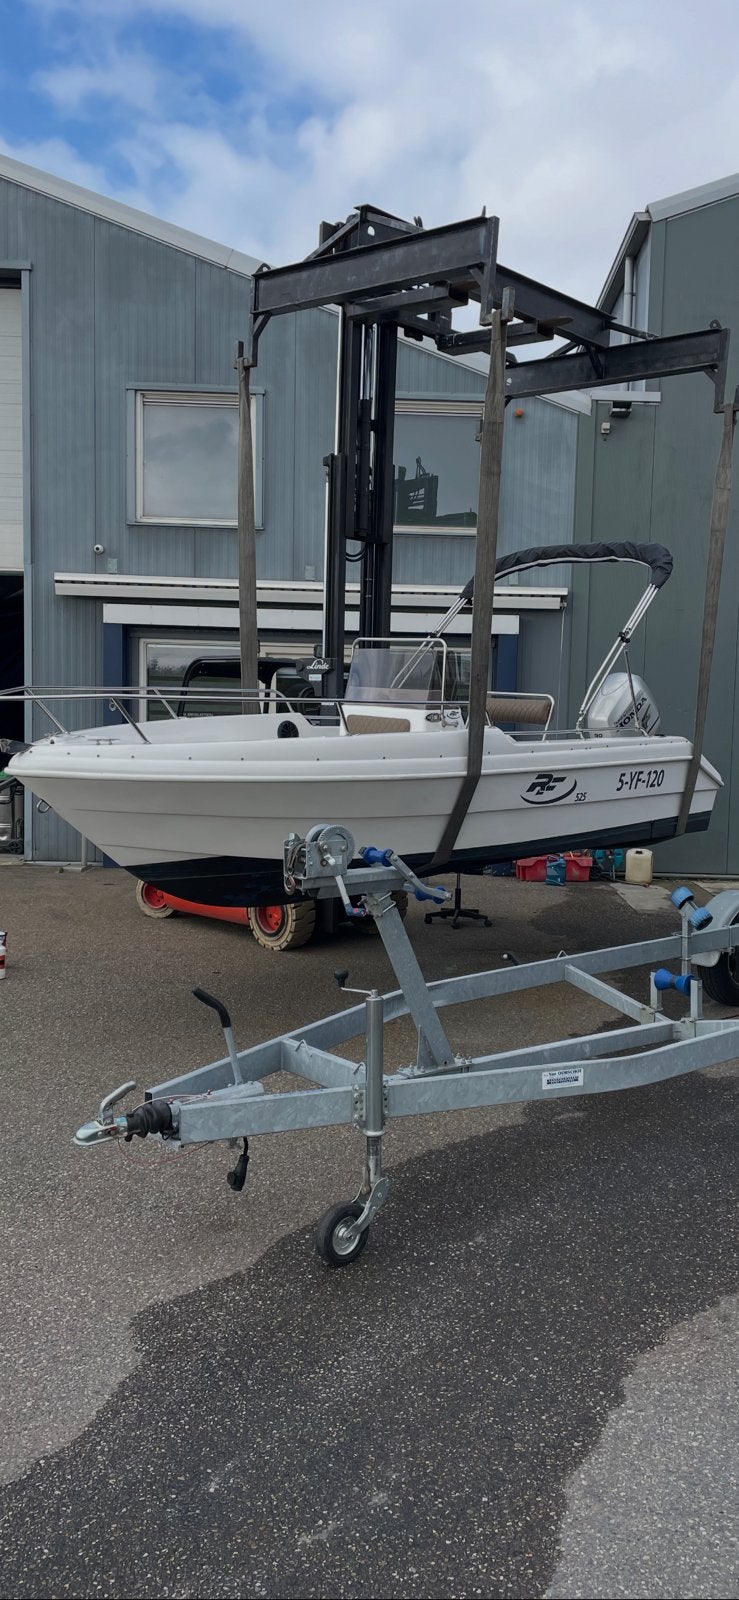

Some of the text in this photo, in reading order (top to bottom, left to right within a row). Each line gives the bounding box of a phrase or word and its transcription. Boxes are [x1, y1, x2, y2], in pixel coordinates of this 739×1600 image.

[306, 658, 330, 670] Linde
[615, 769, 665, 792] 5-YF-120
[574, 792, 588, 802] 525
